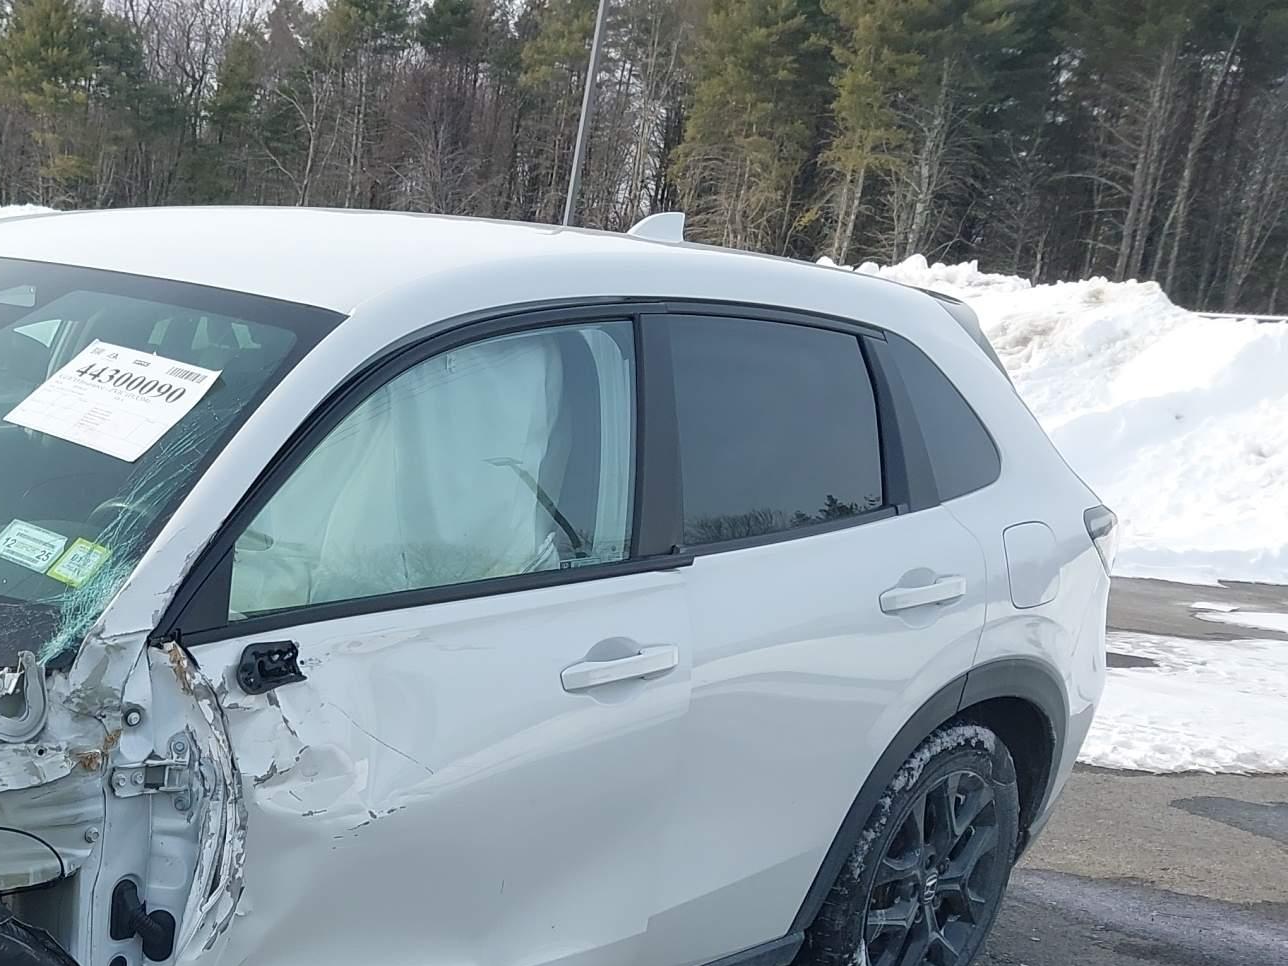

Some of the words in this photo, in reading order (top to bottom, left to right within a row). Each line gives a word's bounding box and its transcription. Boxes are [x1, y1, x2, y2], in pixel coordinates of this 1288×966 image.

[75, 362, 187, 403] 44300090
[2, 536, 17, 548] 12
[35, 550, 52, 562] 25
